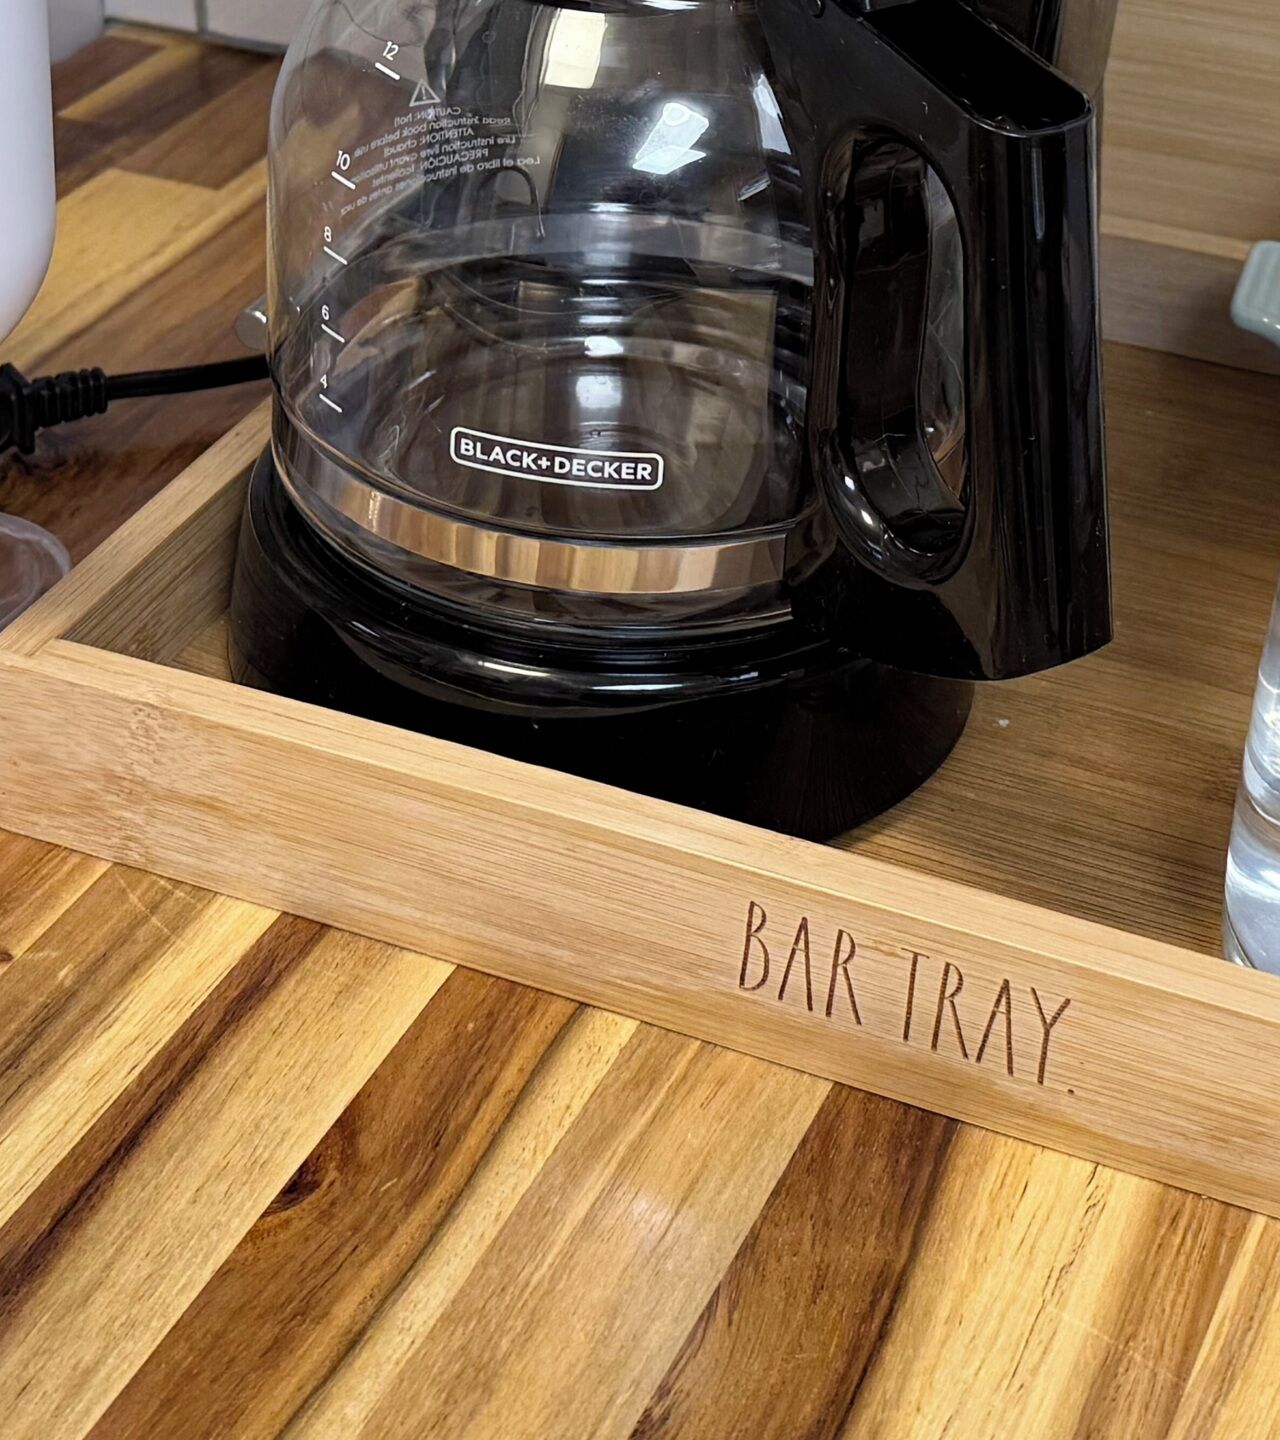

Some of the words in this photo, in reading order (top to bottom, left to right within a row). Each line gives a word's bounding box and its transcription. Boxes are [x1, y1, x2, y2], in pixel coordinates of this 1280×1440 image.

[382, 41, 399, 61] 12
[336, 150, 351, 170] 10
[323, 225, 332, 242] 8
[321, 304, 330, 321] 6
[320, 374, 328, 389] 4
[459, 438, 652, 481] BLACK+DECKER
[738, 900, 862, 1026] BAR
[901, 946, 1075, 1095] TRAY.
